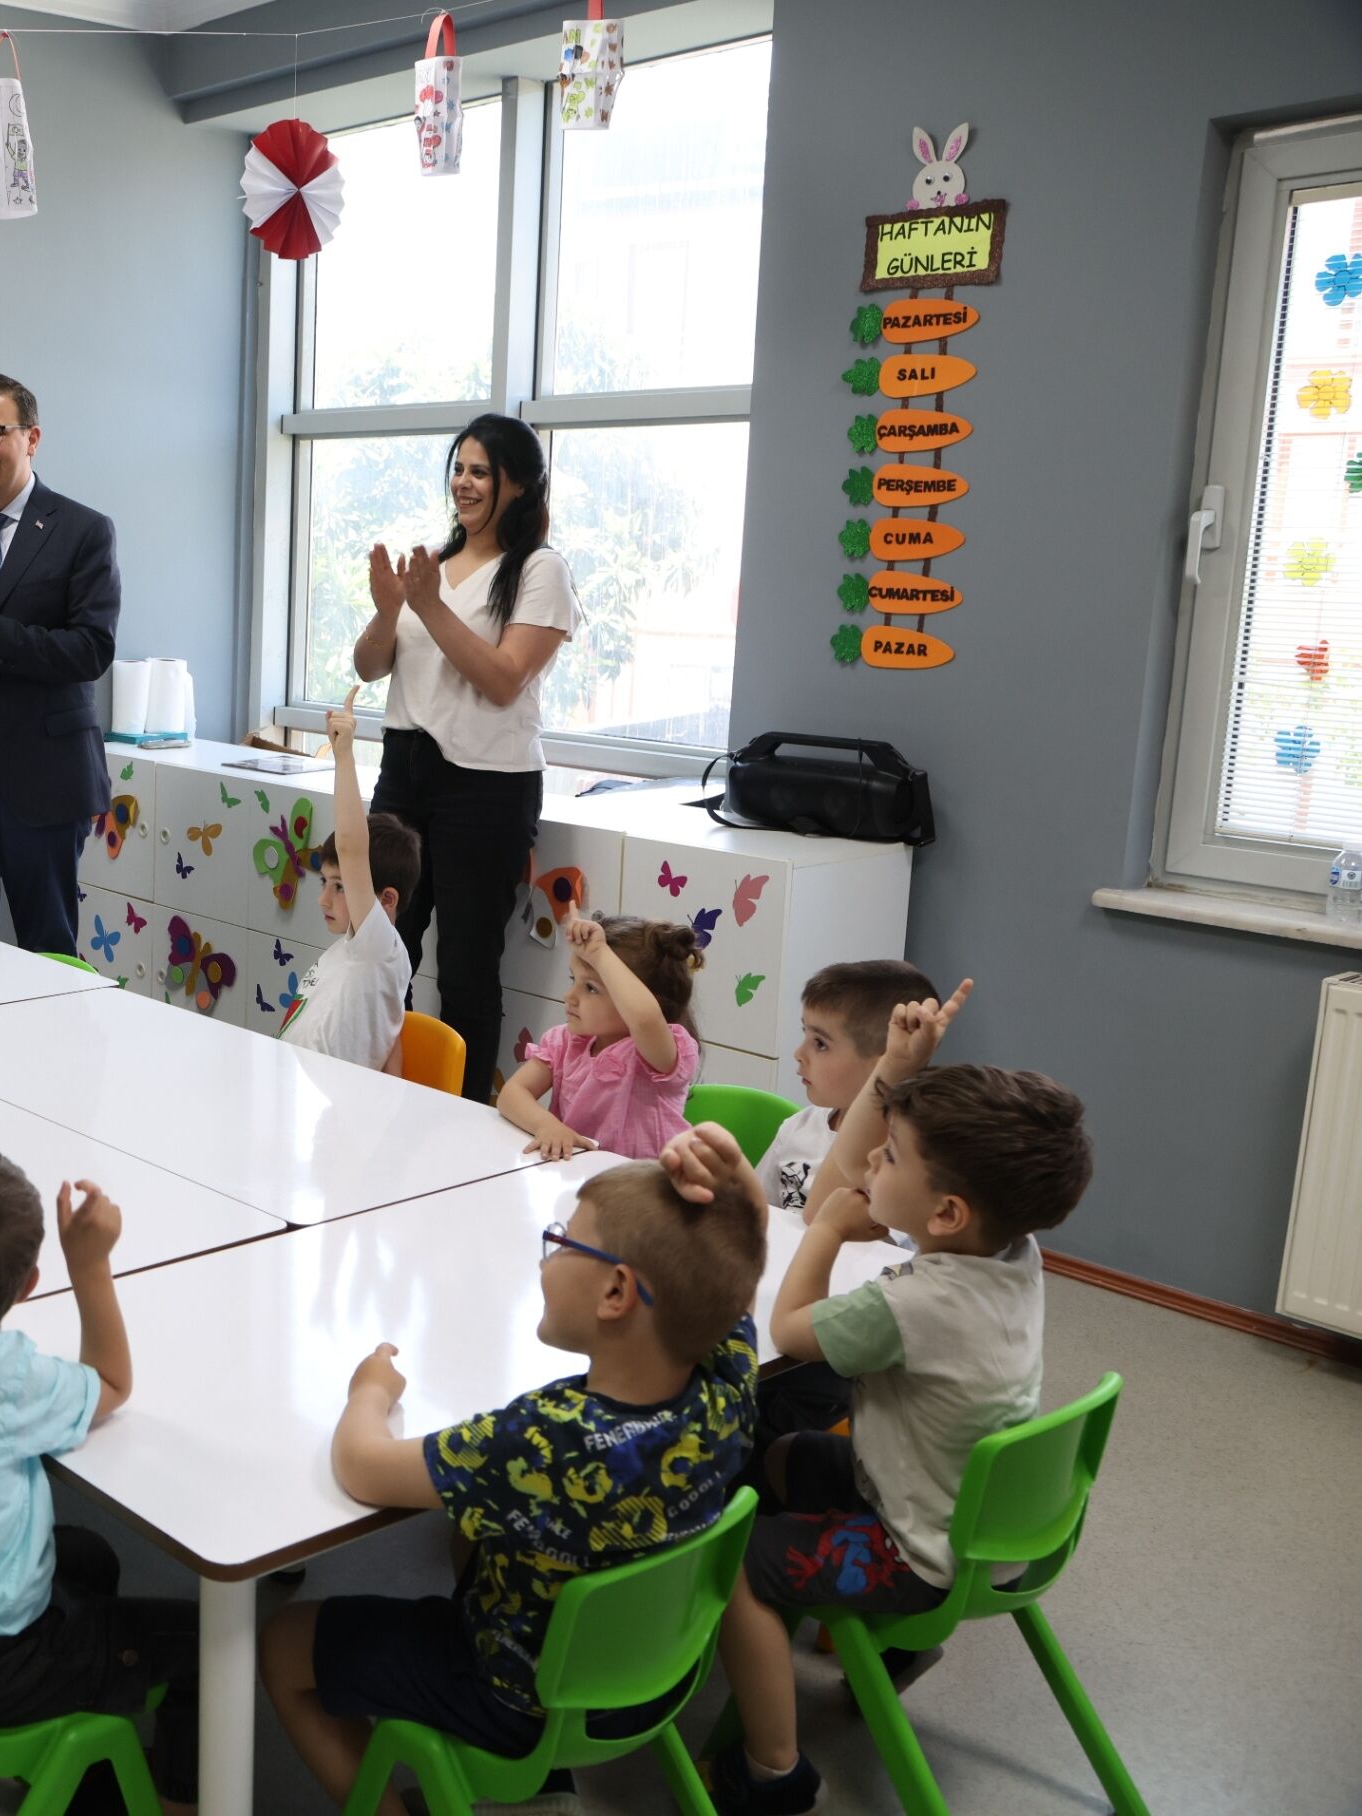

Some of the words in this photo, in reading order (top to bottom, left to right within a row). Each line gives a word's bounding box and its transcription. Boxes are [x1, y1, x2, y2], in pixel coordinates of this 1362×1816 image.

[879, 213, 992, 242] HAFTANIN
[887, 246, 977, 276] GÜNLERİ
[882, 306, 968, 329] PAZARTESİ
[896, 367, 935, 381] SALI
[877, 421, 960, 441] ÇARŞAMBA
[877, 477, 957, 495] PERŞEMBE
[883, 532, 934, 545] CUMA
[868, 585, 955, 602] CUMARTESİ
[873, 640, 928, 656] PAZAR
